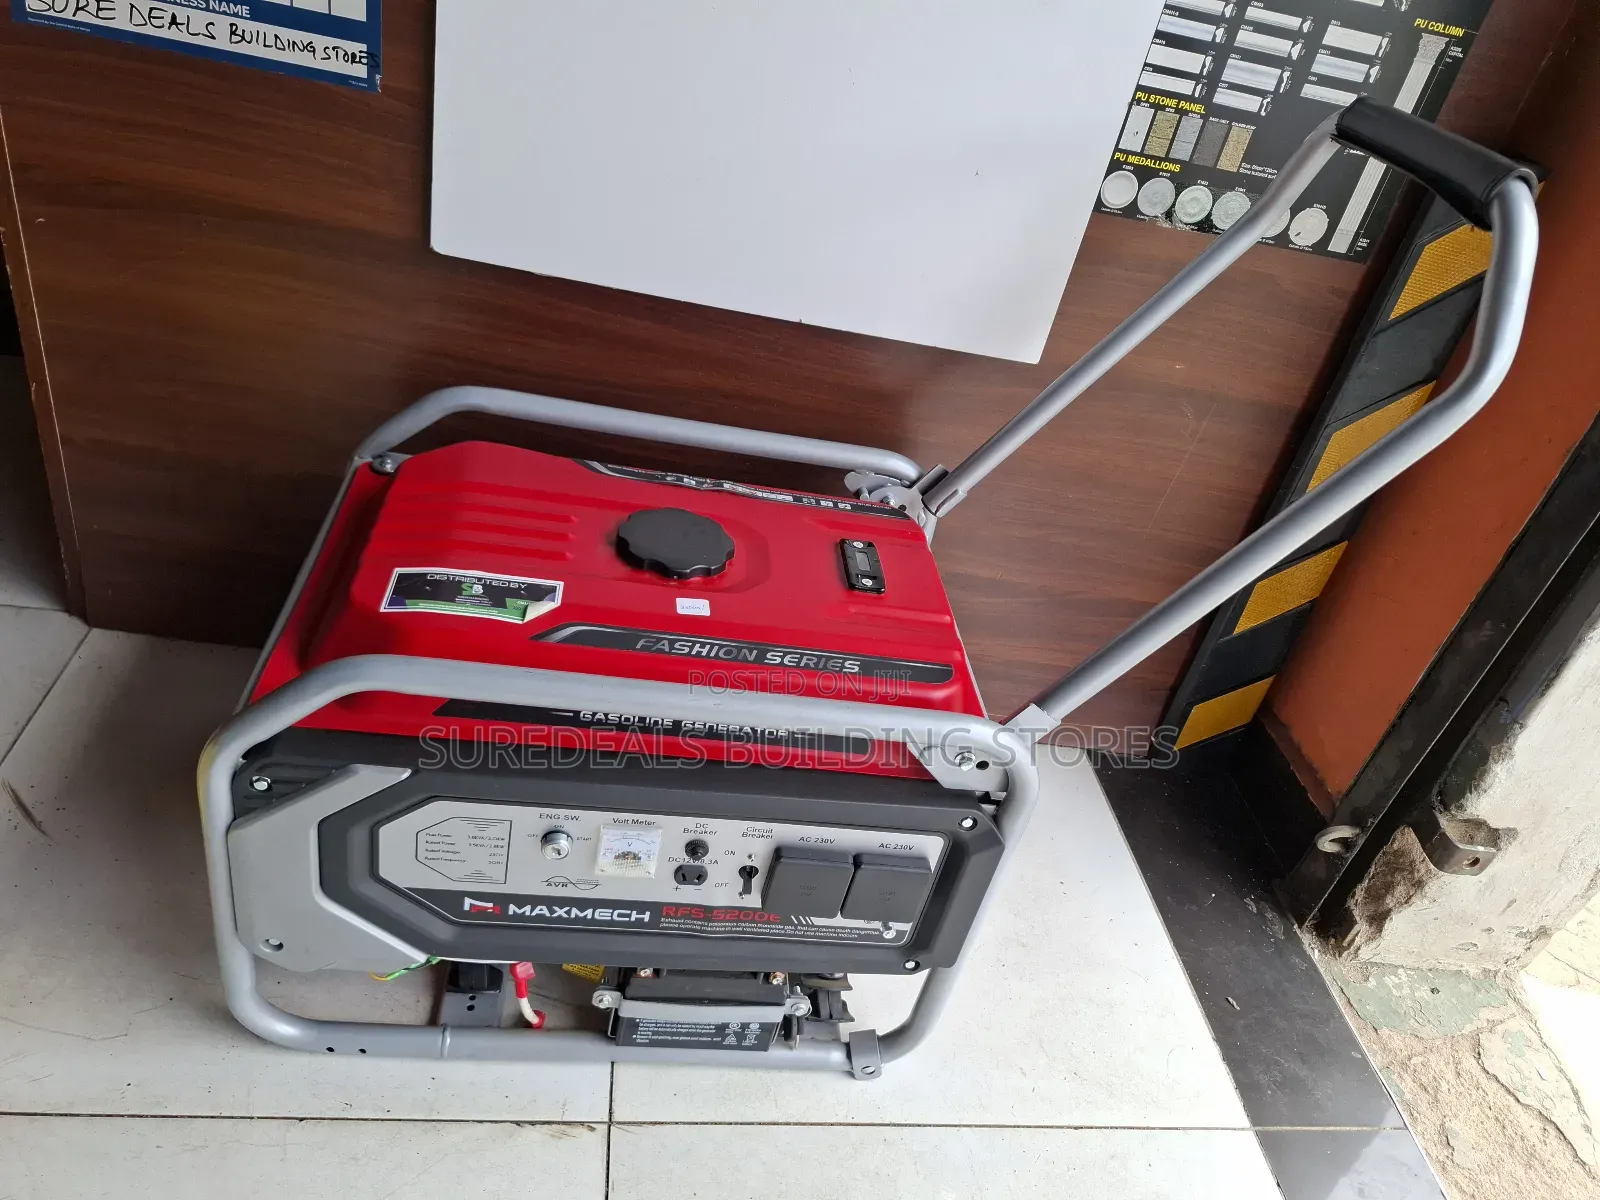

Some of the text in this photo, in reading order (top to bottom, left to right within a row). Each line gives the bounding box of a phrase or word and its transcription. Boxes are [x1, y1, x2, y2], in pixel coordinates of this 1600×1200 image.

[209, 0, 251, 18] NAME
[129, 2, 217, 40] DEALS
[229, 22, 317, 60] BUILDING
[320, 45, 381, 68] STORES
[1414, 18, 1465, 37] PU COLUMN
[1135, 91, 1206, 114] PU STONE PANEL
[1114, 152, 1181, 172] PU MEDALLIONS
[427, 573, 509, 587] DISTRIBUTED
[635, 637, 861, 673] FASHION SERIES
[579, 710, 789, 740] GASOLINE GENERATOR
[612, 817, 630, 825] Volt
[746, 826, 774, 834] Circuit
[682, 828, 718, 836] Breaker
[742, 832, 774, 840] Breaker
[814, 837, 836, 845] 230V
[508, 903, 651, 923] MAXMECH
